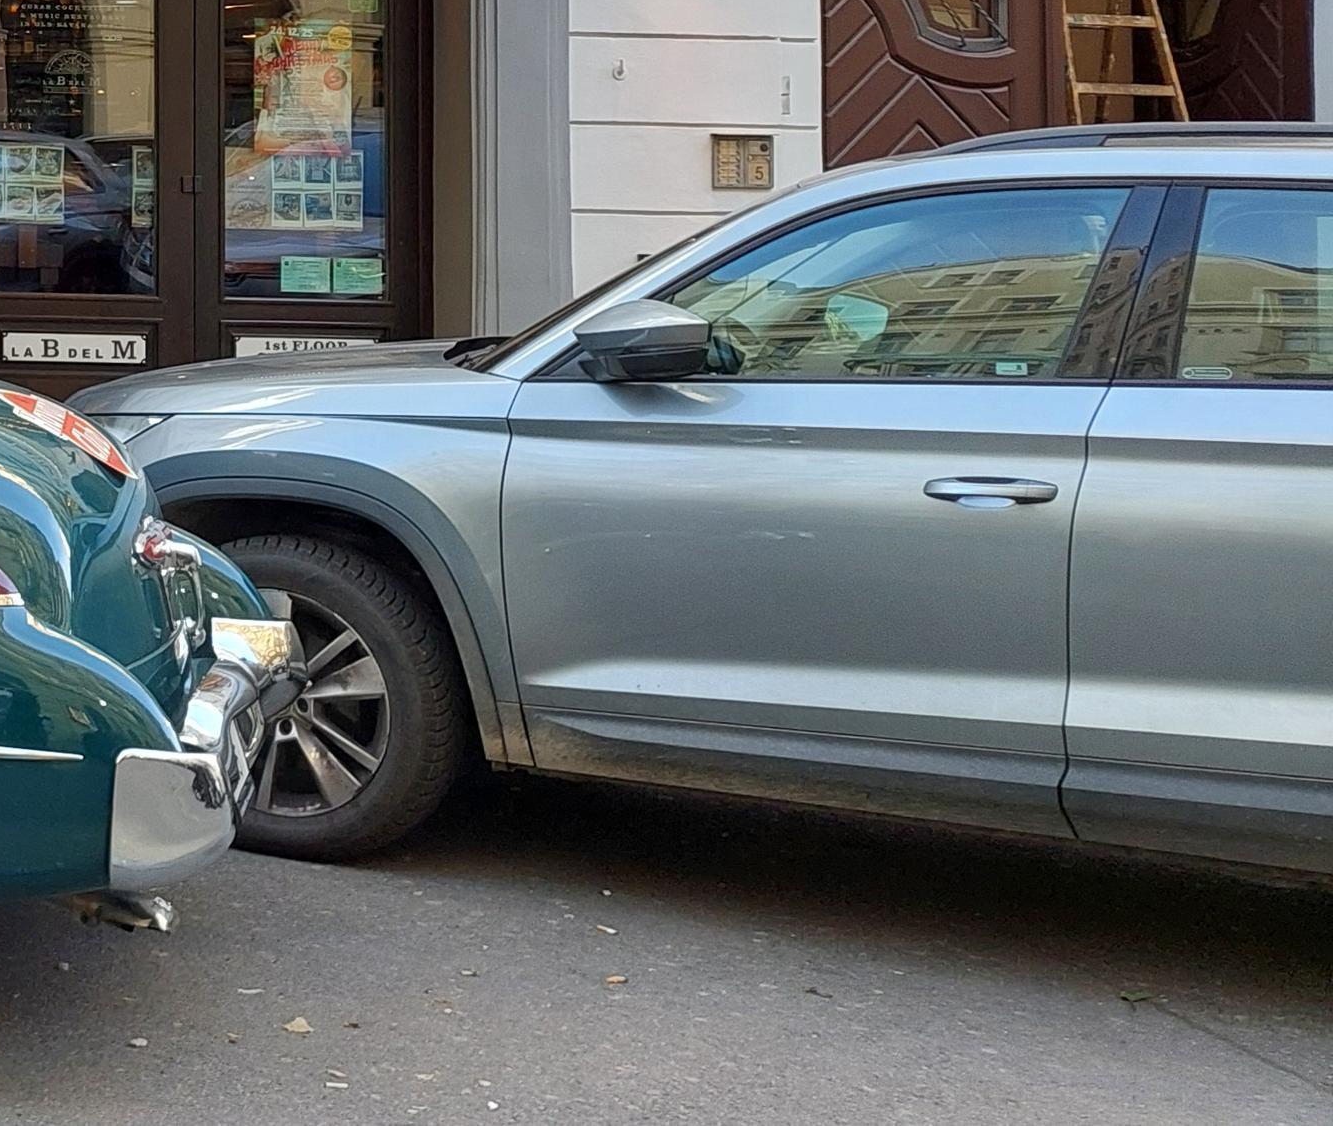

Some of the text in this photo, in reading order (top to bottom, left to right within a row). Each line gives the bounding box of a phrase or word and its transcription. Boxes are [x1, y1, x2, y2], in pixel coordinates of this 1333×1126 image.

[301, 28, 314, 37] 25
[755, 165, 764, 180] 5
[11, 338, 137, 360] LA B DEL M
[265, 341, 288, 351] 1st
